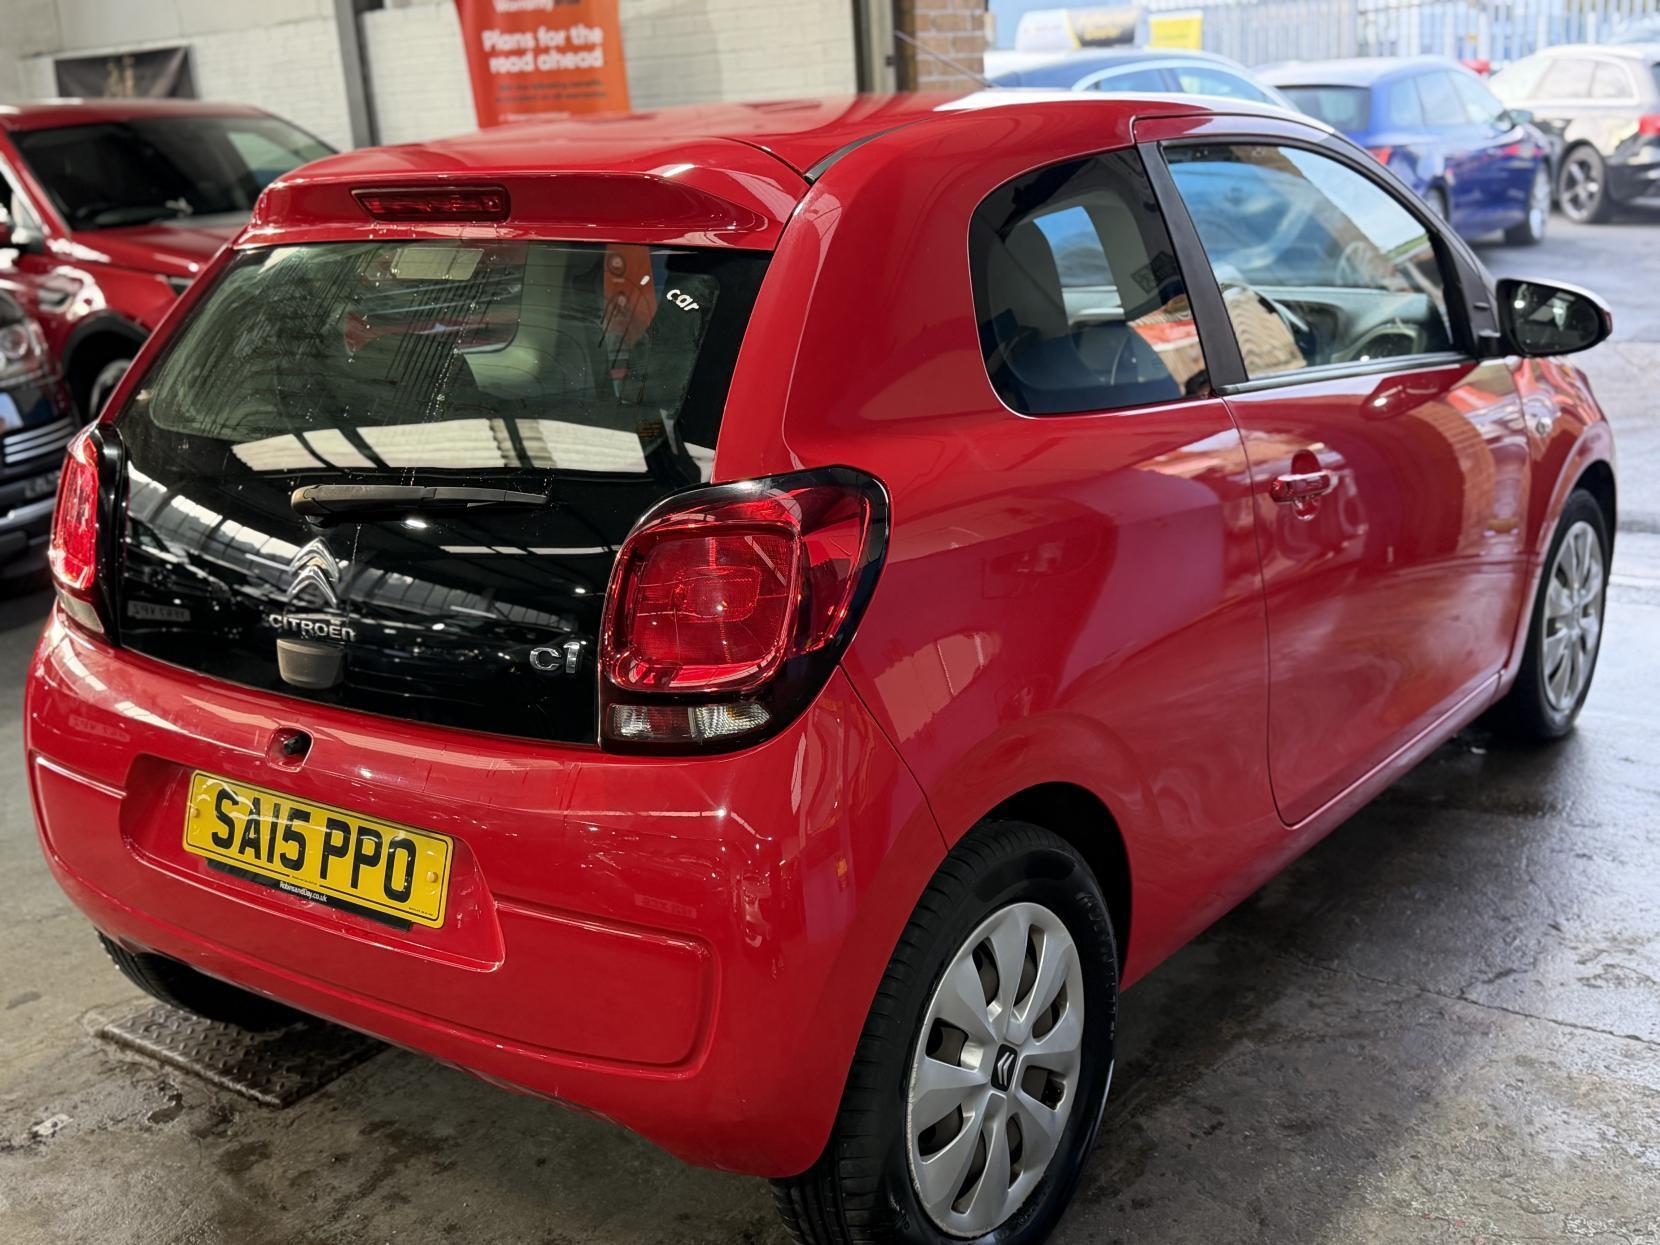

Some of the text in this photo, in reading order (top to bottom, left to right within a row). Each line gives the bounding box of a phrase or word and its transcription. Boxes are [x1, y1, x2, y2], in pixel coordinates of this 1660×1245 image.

[481, 23, 604, 51] Plans for the
[488, 47, 604, 74] road ahead
[666, 289, 700, 311] car
[211, 787, 417, 904] SA15 PPO
